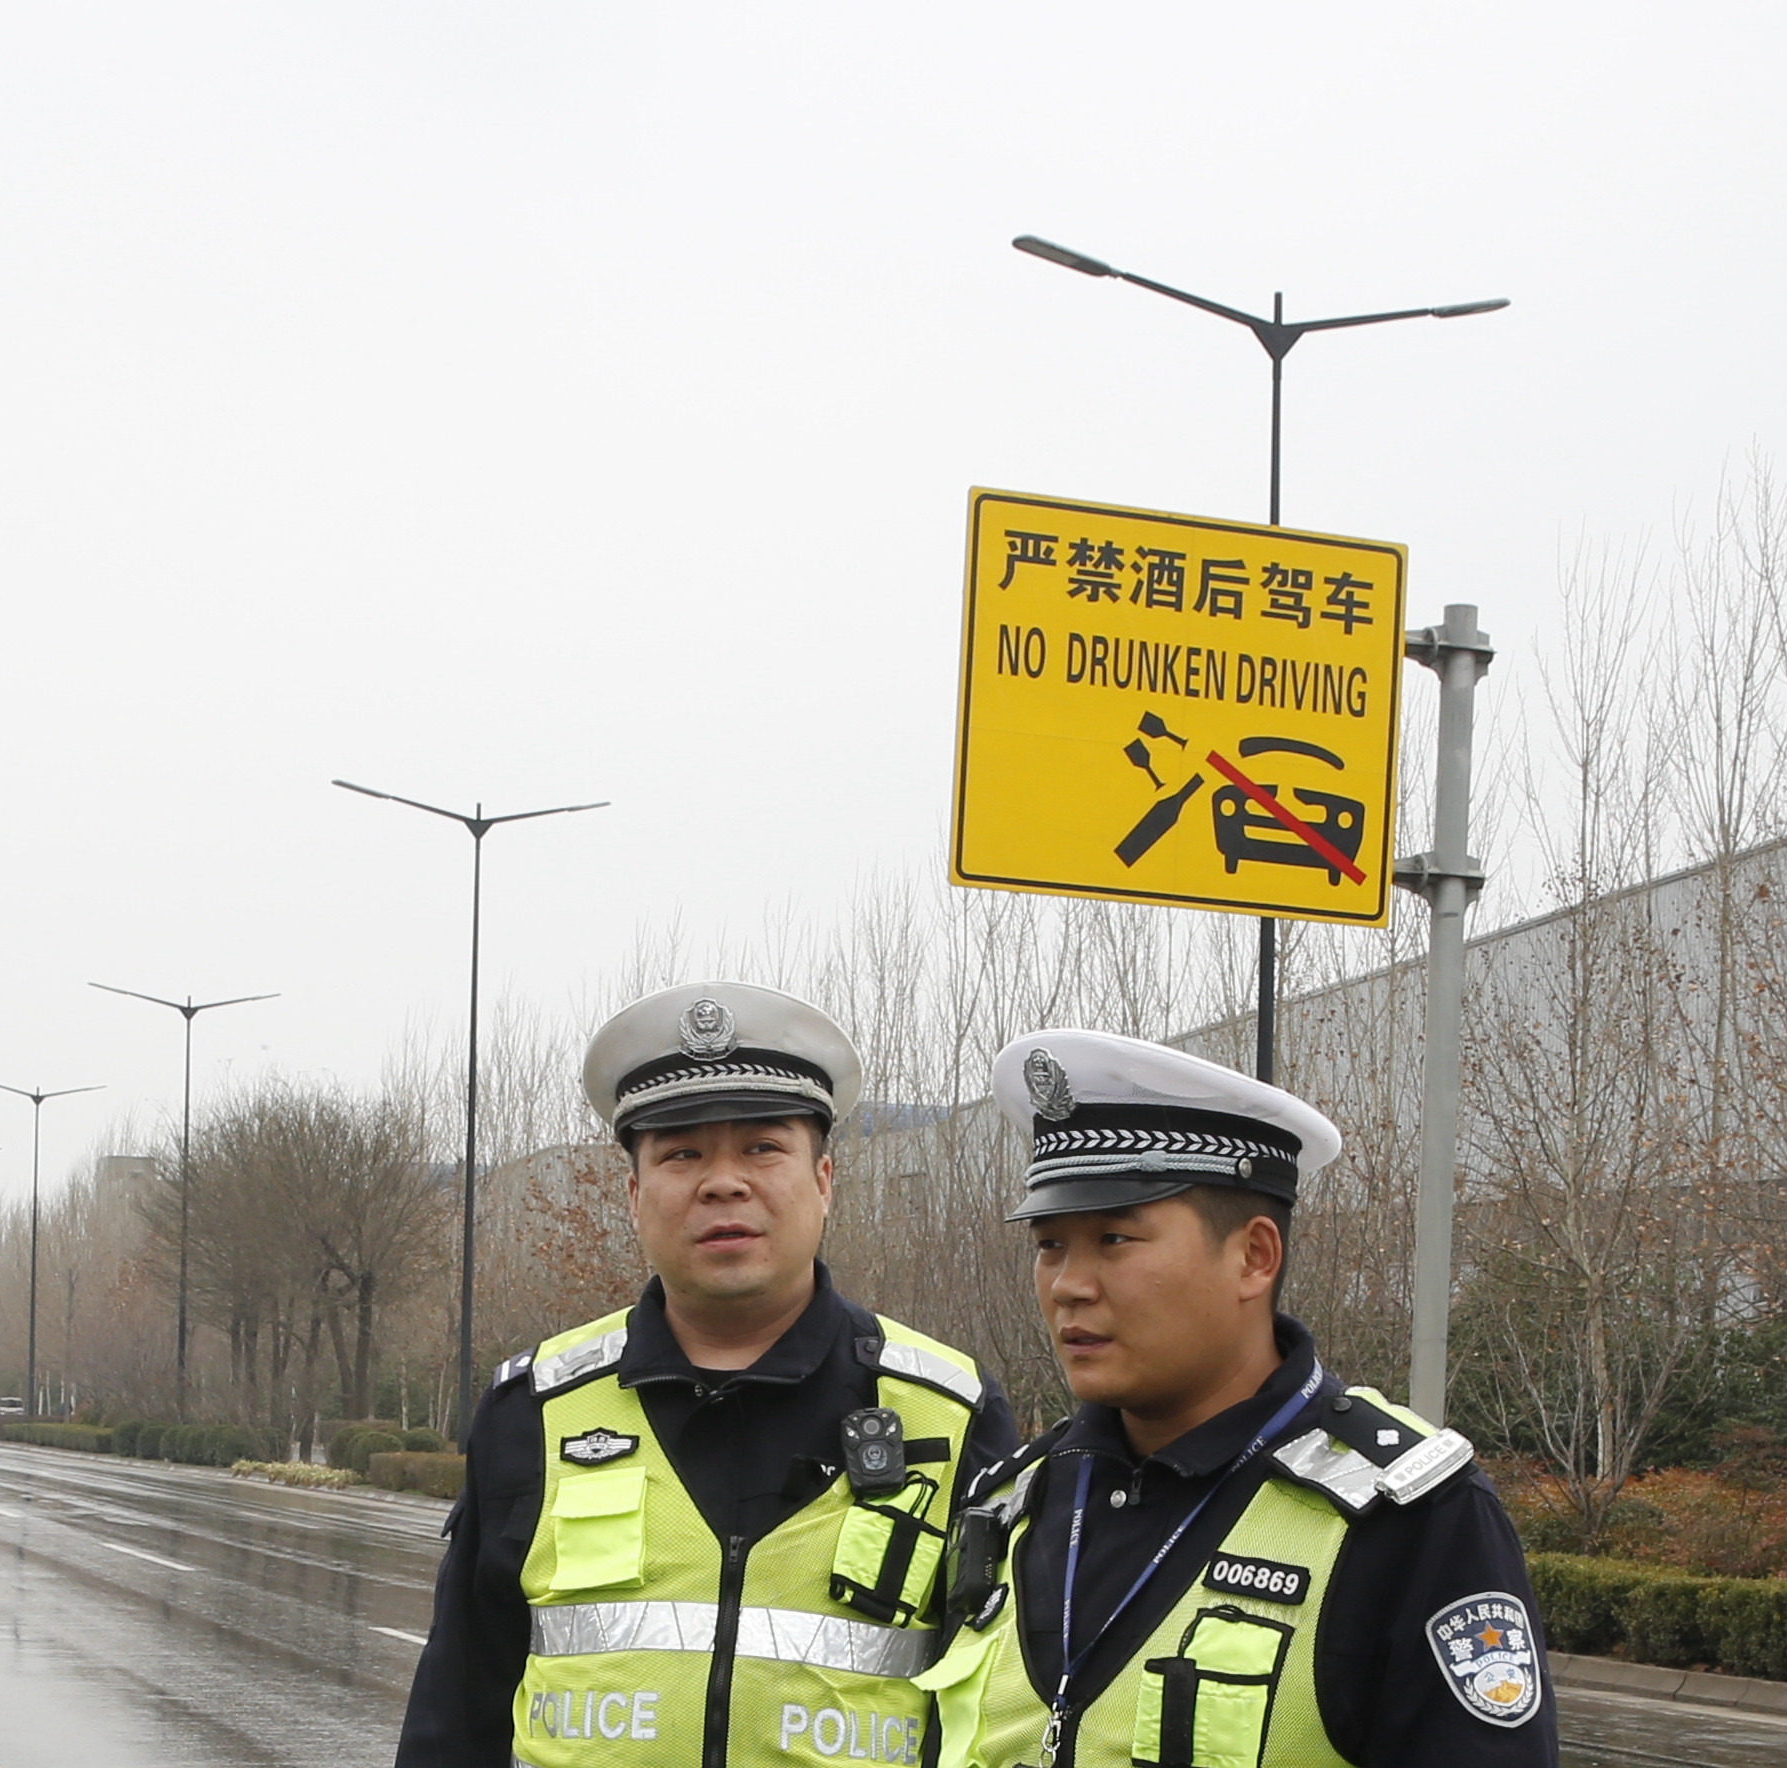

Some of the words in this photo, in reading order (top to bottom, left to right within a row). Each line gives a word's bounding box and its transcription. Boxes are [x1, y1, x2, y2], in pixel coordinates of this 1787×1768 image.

[998, 529, 1374, 635] 严禁酒后驾车
[997, 624, 1046, 679] NO
[1066, 632, 1228, 702] DRUNKEN
[1235, 653, 1369, 718] DRIVING
[1404, 1444, 1447, 1476] POLICE
[1212, 1560, 1299, 1596] 006869
[1436, 1603, 1524, 1641] 中华人民共和国
[1448, 1637, 1474, 1661] 警
[1506, 1628, 1526, 1650] 察
[530, 1690, 661, 1740] POLICE
[780, 1703, 919, 1765] POLICE
